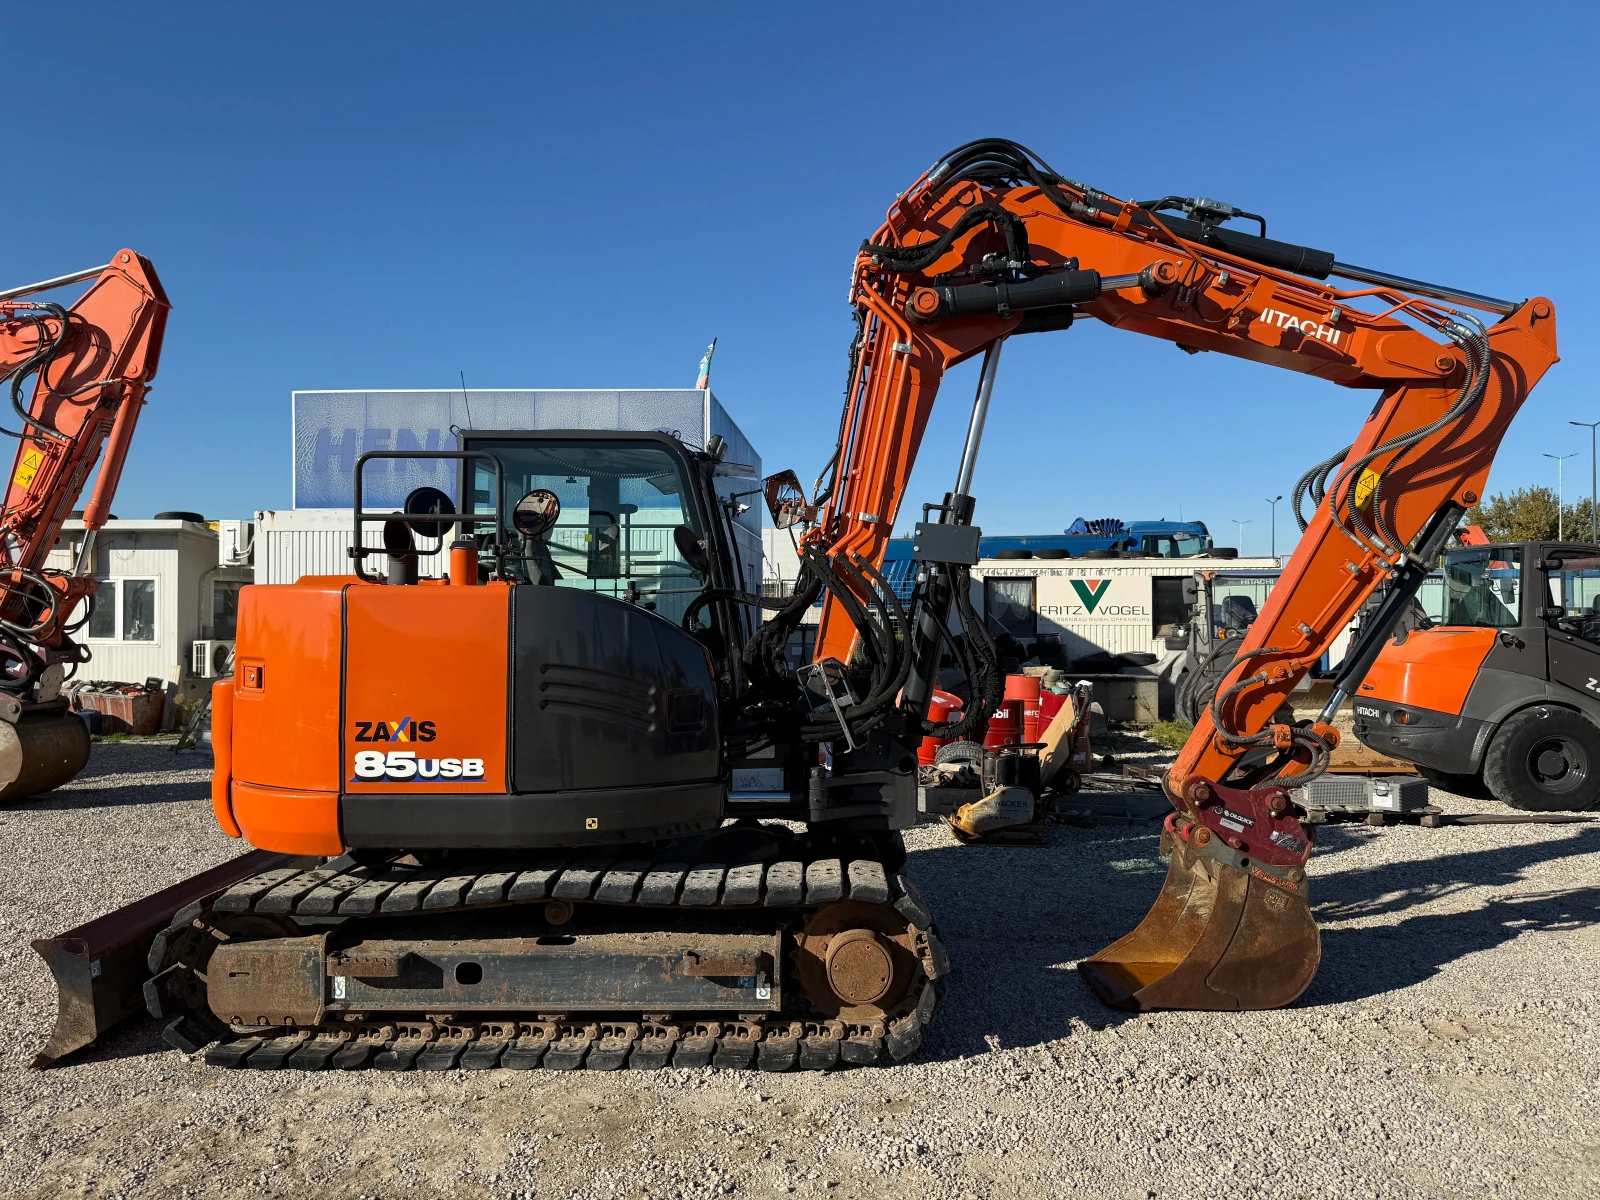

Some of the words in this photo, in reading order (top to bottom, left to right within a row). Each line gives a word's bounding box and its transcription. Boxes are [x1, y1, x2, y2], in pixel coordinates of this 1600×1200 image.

[1039, 606, 1083, 615] FRITZ
[1098, 606, 1150, 615] VOGEL
[1585, 676, 1600, 694] Z
[1356, 705, 1380, 718] HITACHI
[354, 716, 437, 742] ZAXIS
[993, 799, 1029, 808] WACKER
